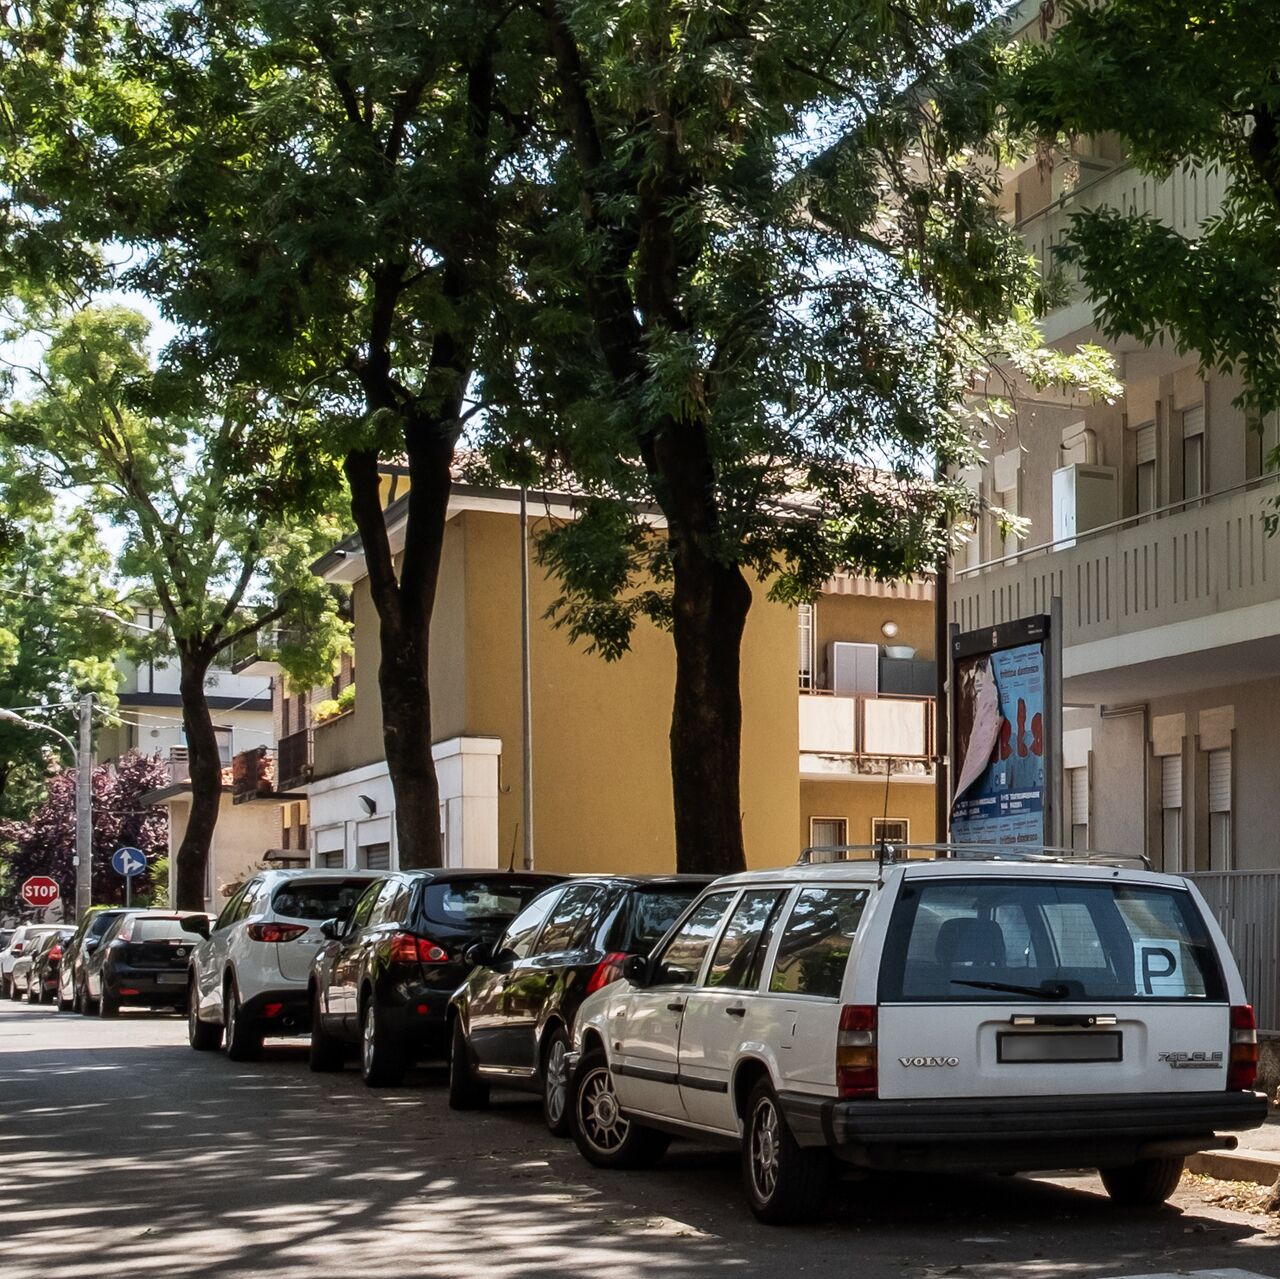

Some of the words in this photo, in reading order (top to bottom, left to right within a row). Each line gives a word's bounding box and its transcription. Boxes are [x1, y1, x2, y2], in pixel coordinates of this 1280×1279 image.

[25, 885, 57, 898] STOP
[1141, 946, 1177, 995] P
[898, 1056, 960, 1068] VOLVO
